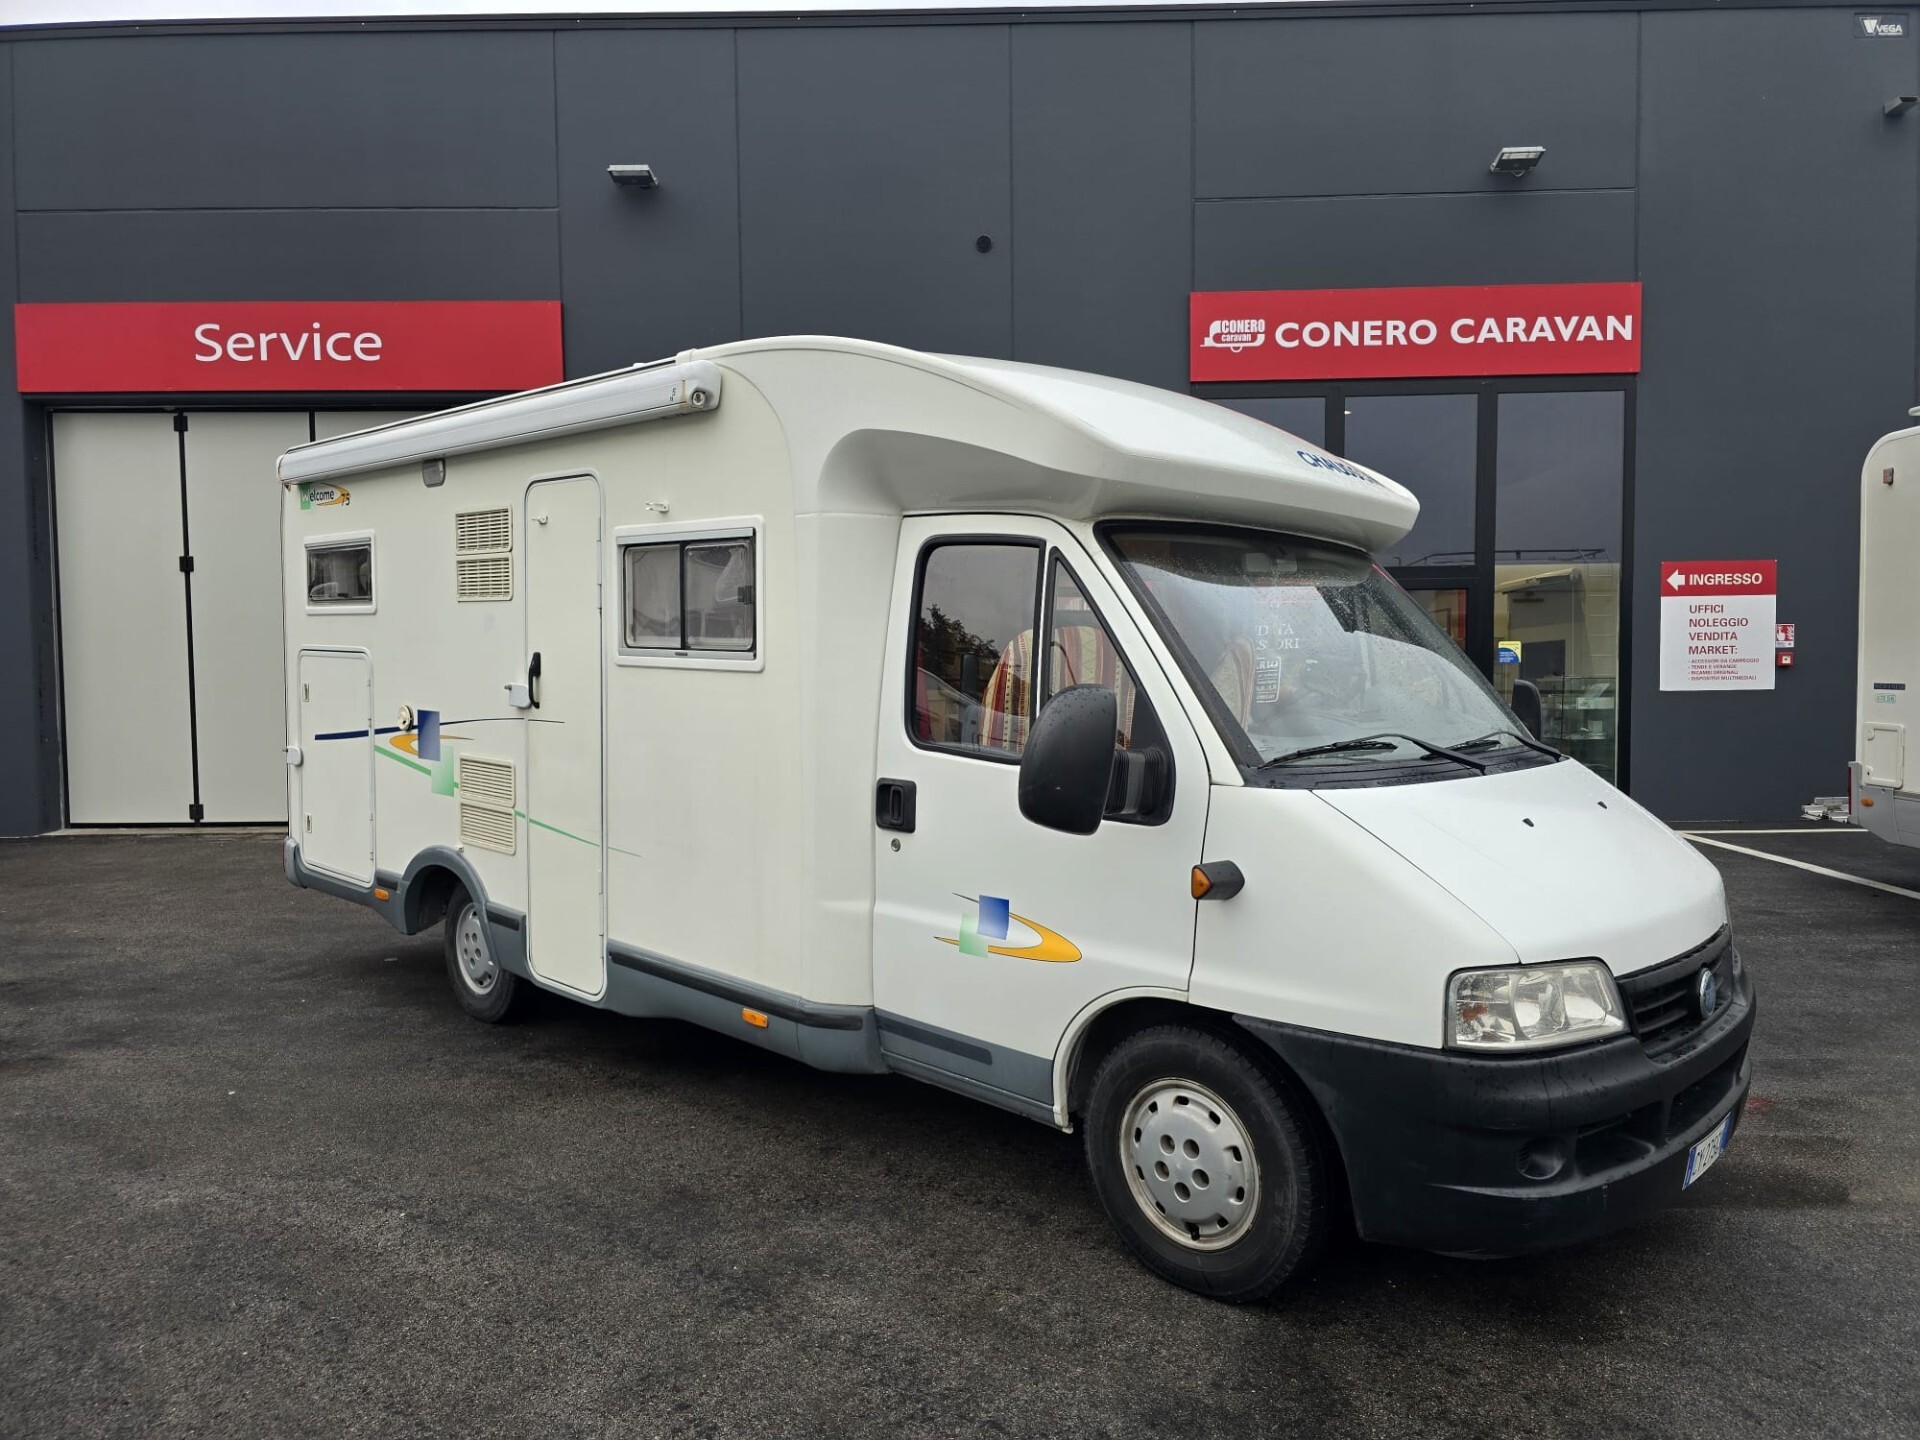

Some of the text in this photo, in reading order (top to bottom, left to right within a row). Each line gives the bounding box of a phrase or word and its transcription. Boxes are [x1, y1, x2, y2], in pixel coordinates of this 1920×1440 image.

[1876, 24, 1903, 33] VEGA
[1221, 319, 1265, 333] CONERO
[1275, 315, 1633, 349] CONERO CARAVAN
[194, 322, 382, 362] Service
[1221, 333, 1252, 342] caravan
[1689, 573, 1763, 585] INGRESSO
[1689, 604, 1724, 614] UFFICI
[1689, 617, 1749, 627] NOLEGGIO
[1689, 632, 1738, 641] VENDITA
[1688, 646, 1738, 655] MARKET:
